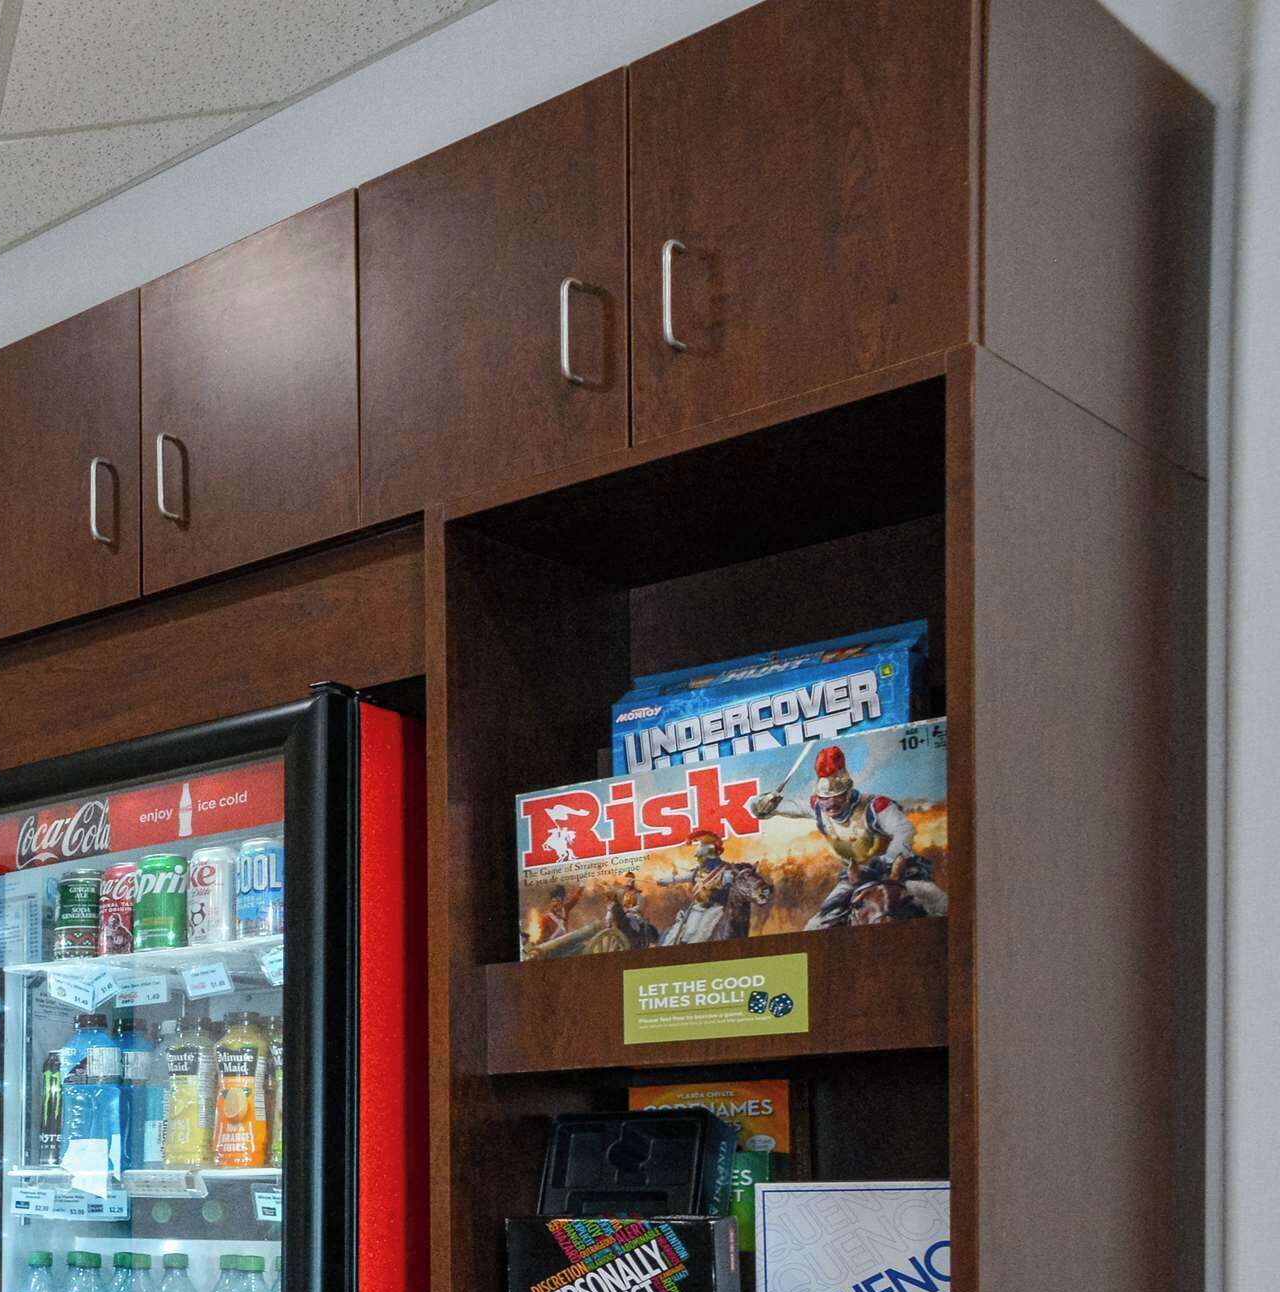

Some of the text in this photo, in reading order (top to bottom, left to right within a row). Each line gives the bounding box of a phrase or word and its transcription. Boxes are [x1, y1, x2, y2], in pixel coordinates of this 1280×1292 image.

[616, 706, 662, 724] MONTOY
[624, 670, 881, 773] UNDERCOVER
[899, 735, 925, 750] 10+
[139, 790, 248, 824] enjoy ice cold
[16, 799, 112, 870] Coca-Cola
[539, 867, 562, 879] Game
[574, 859, 609, 873] Strategic
[610, 854, 651, 868] Conquest
[639, 975, 766, 997] LET THE GOOD
[639, 991, 745, 1010] TIMES ROLL!
[218, 1051, 254, 1063] Minute
[223, 1062, 248, 1073] Maid
[614, 1220, 646, 1244] ALERT
[658, 1222, 689, 1261] ATTENTION
